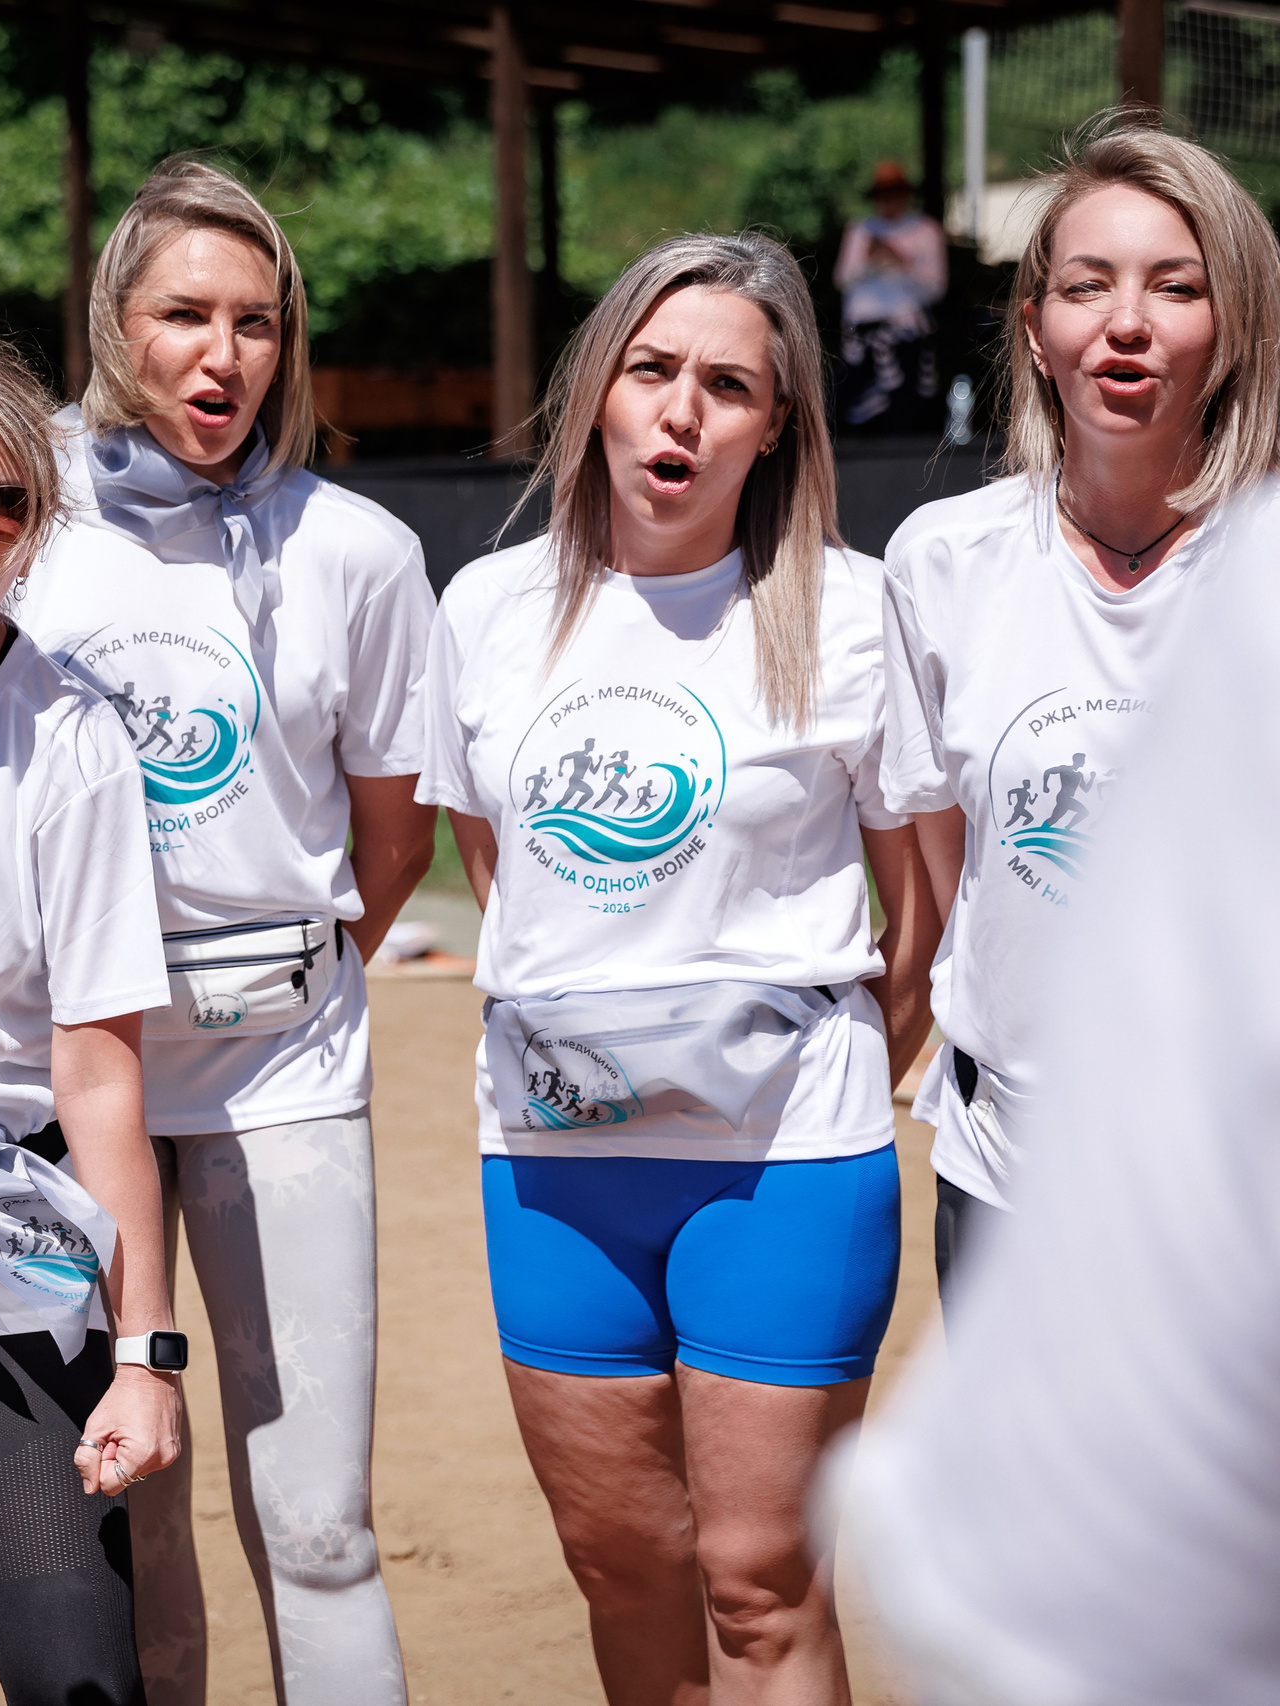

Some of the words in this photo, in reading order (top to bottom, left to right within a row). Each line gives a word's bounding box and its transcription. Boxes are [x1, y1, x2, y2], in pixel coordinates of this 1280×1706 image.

[149, 813, 191, 833] НОЙ
[194, 781, 249, 826] ВОЛНЕ
[149, 842, 170, 853] 026
[524, 837, 554, 868] МЫ
[553, 861, 577, 884] НА
[583, 870, 650, 895] ОДНОЙ
[651, 834, 707, 883] ВОЛНЕ
[1007, 854, 1043, 890] МЫ
[602, 902, 631, 913] 2026
[521, 1108, 536, 1130] МЫ
[10, 1270, 32, 1285] МЫ
